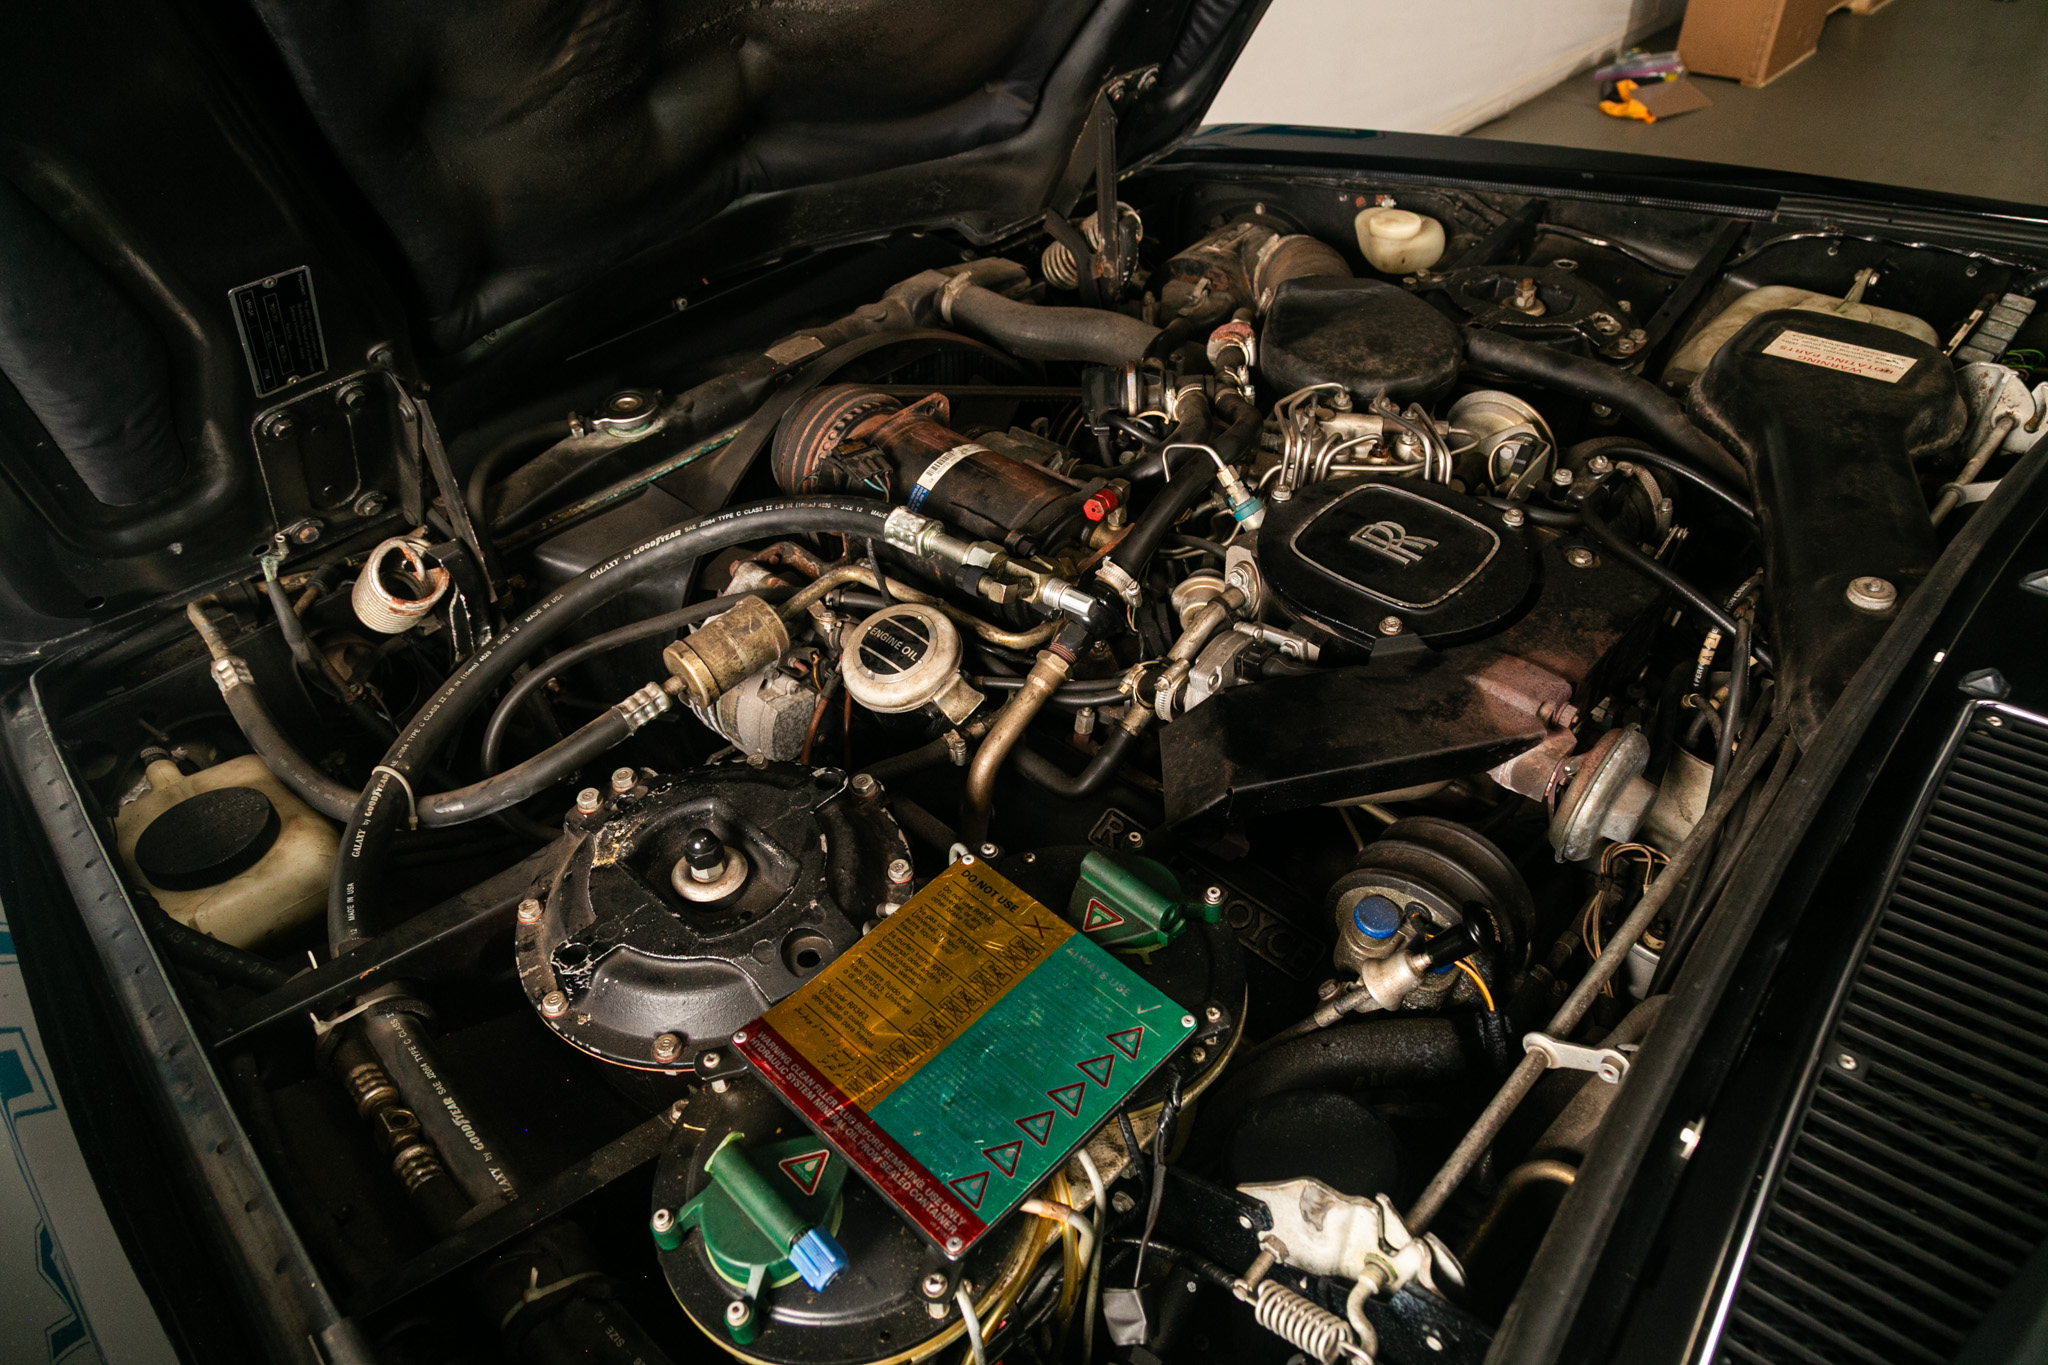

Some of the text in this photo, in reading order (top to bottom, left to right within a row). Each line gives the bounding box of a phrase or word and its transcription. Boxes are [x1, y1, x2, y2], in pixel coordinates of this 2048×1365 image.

[1777, 344, 1823, 358] PARTS
[1795, 354, 1864, 373] WARNING
[1823, 354, 1894, 374] ROTATING
[590, 557, 620, 579] GALAXY
[624, 553, 632, 562] by
[632, 529, 682, 555] GOODYEAR
[684, 523, 697, 533] SAE
[717, 512, 734, 522] TYPE
[743, 506, 764, 516] CLASS
[870, 508, 889, 520] MADE
[869, 627, 919, 662] ENGINE OIL
[406, 728, 421, 743] TYPE
[423, 704, 441, 721] CLASS
[497, 633, 512, 645] SIZE
[511, 626, 520, 634] 12
[524, 608, 543, 623] MADE
[542, 602, 551, 610] IN
[550, 593, 565, 604] USA
[351, 773, 391, 858] GALAXY by GOODYEAR
[346, 882, 355, 896] USA
[941, 884, 954, 894] Do
[950, 891, 964, 902] not
[960, 899, 974, 910] use
[959, 868, 1020, 913] DO NOT USE
[346, 904, 356, 922] MADE
[929, 894, 947, 909] other
[944, 906, 964, 921] brake
[903, 916, 921, 931] autre
[868, 945, 900, 972] verwendet
[881, 934, 943, 985] Universal oder andere
[913, 950, 932, 966] keine
[1063, 945, 1132, 997] ALWAYS USE
[824, 982, 836, 993] No
[832, 990, 848, 1004] usar
[852, 976, 870, 991] altro
[854, 956, 913, 1006] Non usare fluido per
[810, 992, 826, 1006] otro
[839, 1019, 856, 1034] para
[817, 987, 846, 1012] Universal
[846, 1012, 876, 1039] cualquier
[883, 990, 914, 1017] Universal
[389, 1018, 408, 1040] CLASS
[407, 1045, 424, 1063] TYPE
[419, 1061, 437, 1080] J2064
[432, 1079, 447, 1096] SAE
[442, 1096, 485, 1151] GOODYEAR
[748, 1035, 790, 1076] HYDRAULIC
[784, 1070, 817, 1102] SYSTEM
[811, 1096, 848, 1131] MINERAL
[843, 1125, 861, 1143] OIL
[855, 1137, 884, 1164] FROM
[878, 1158, 913, 1192] SEALED
[907, 1185, 959, 1236] CONTAINER
[482, 1152, 493, 1163] by
[788, 1061, 816, 1088] CLEAN
[811, 1082, 839, 1108] FILLER
[834, 1103, 858, 1126] PLUG
[852, 1120, 886, 1152] BEFORE
[922, 1185, 945, 1207] USE
[938, 1200, 967, 1229] ONLY
[604, 1324, 625, 1348] SIZE
